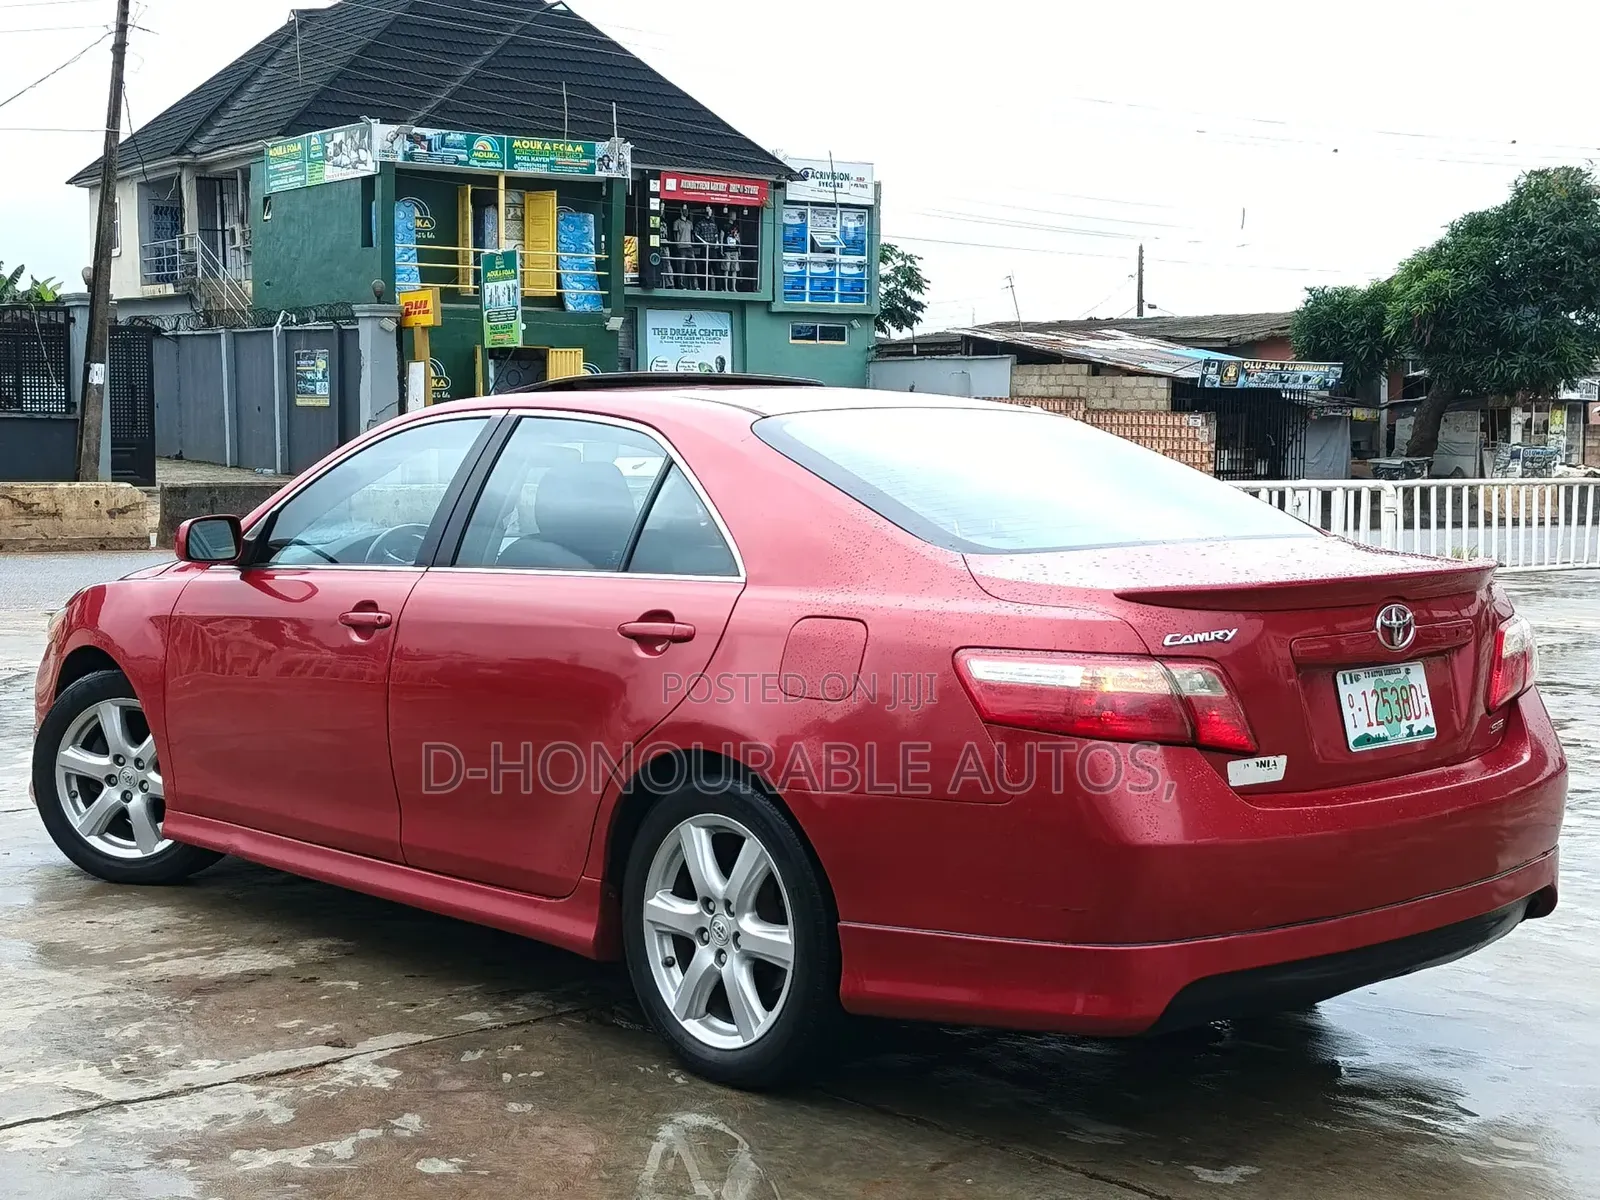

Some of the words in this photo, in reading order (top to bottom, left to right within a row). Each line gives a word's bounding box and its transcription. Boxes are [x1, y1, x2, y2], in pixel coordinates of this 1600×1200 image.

[513, 139, 551, 151] MOUKA
[553, 143, 584, 153] FOAM
[472, 151, 500, 159] MOUKA
[404, 300, 429, 317] DHL
[652, 328, 668, 336] THE
[669, 328, 697, 336] DREAM
[698, 329, 728, 337] CENTRE
[1243, 361, 1281, 370] OLU-SAL
[1283, 363, 1330, 373] FURNITURE
[1163, 628, 1238, 647] CAMRY
